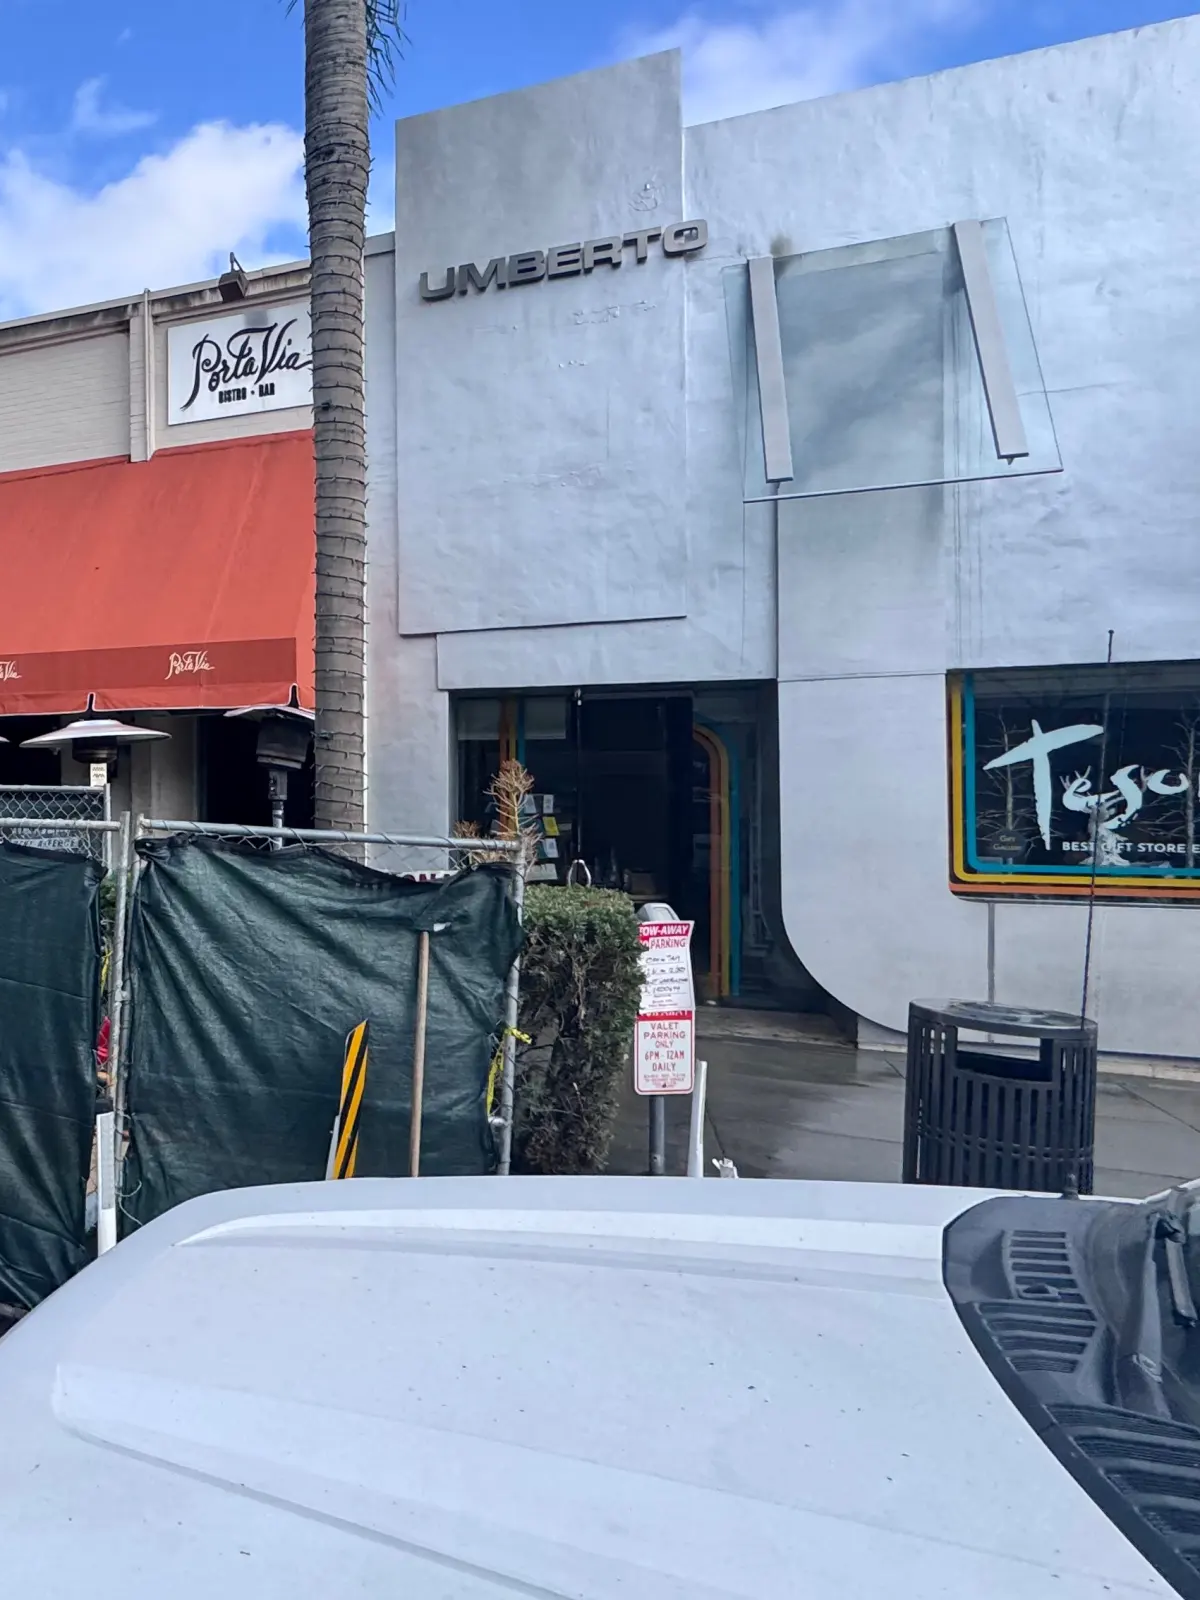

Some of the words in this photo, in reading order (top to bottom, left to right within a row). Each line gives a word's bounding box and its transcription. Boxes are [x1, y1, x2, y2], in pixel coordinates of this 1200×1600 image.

[420, 218, 708, 302] UMBERTO
[180, 326, 260, 412] Porta
[255, 318, 313, 386] Via
[218, 387, 247, 404] BISTRO
[258, 382, 275, 397] BAR
[983, 719, 1200, 850] Teso
[1137, 843, 1186, 853] STORE
[650, 938, 686, 949] PARKING
[650, 1022, 679, 1031] VALET
[643, 1031, 686, 1040] PARKING
[655, 1041, 675, 1049] ONLY
[644, 1051, 660, 1061] 6PM
[666, 1050, 685, 1060] 12AM
[652, 1062, 676, 1072] DAILY
